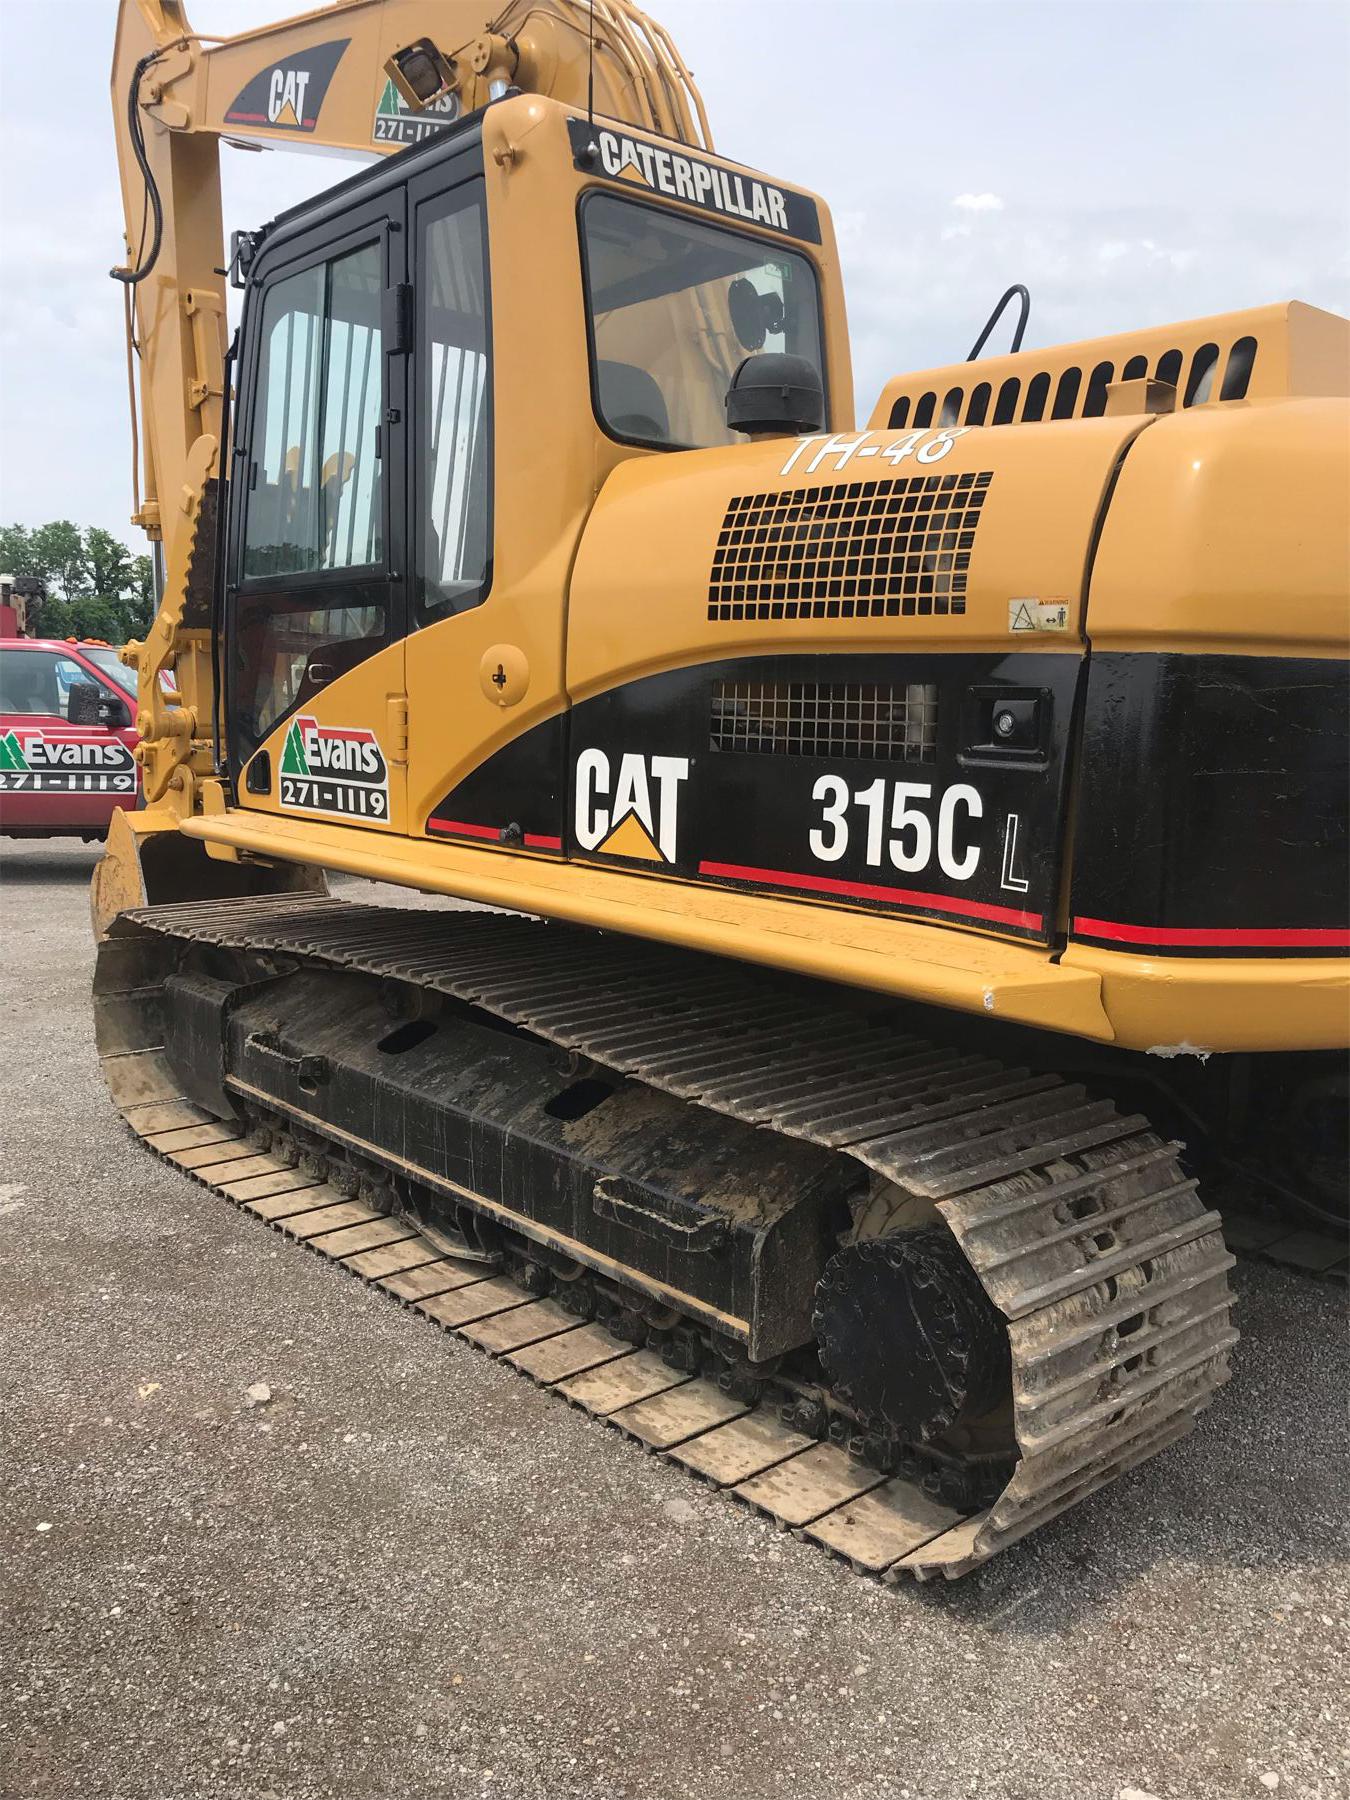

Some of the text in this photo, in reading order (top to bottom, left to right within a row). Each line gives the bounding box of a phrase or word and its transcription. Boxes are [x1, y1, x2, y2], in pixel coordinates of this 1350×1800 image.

[268, 69, 310, 126] CAT
[376, 120, 440, 142] 271-11
[599, 132, 789, 230] CATERPILLAR
[780, 427, 972, 476] TH-48
[24, 737, 125, 765] Evans
[305, 728, 379, 774] Evans
[283, 780, 385, 816] 271-1119
[575, 748, 689, 864] CAT
[809, 774, 1029, 893] 315C L
